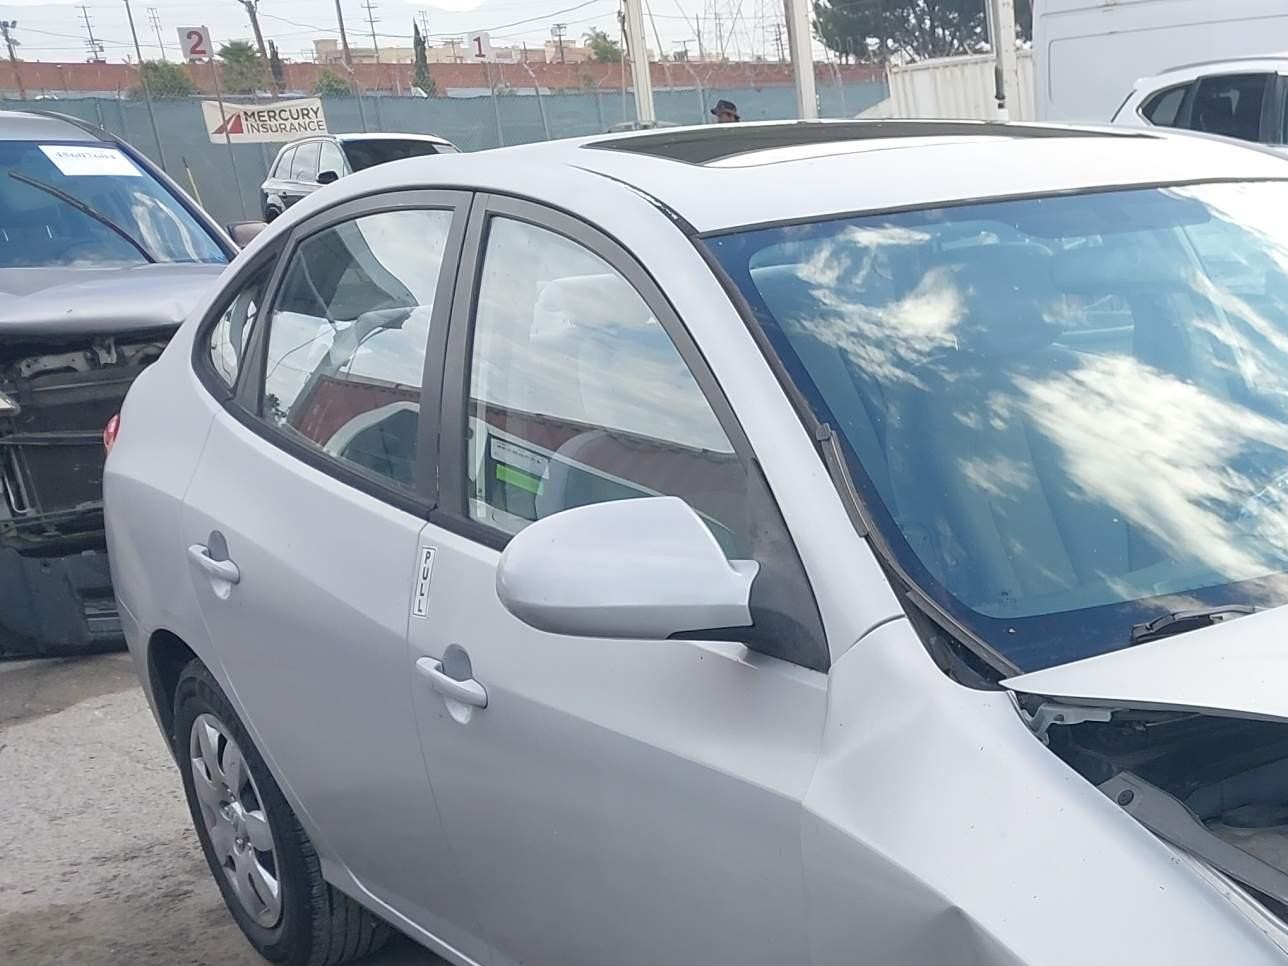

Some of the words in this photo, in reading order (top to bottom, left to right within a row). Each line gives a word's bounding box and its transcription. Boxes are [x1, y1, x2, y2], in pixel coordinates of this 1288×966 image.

[186, 30, 207, 55] 2
[472, 36, 486, 58] 1
[243, 106, 320, 123] MERCURY
[246, 119, 326, 134] INSURANCE
[417, 550, 432, 613] PULL
